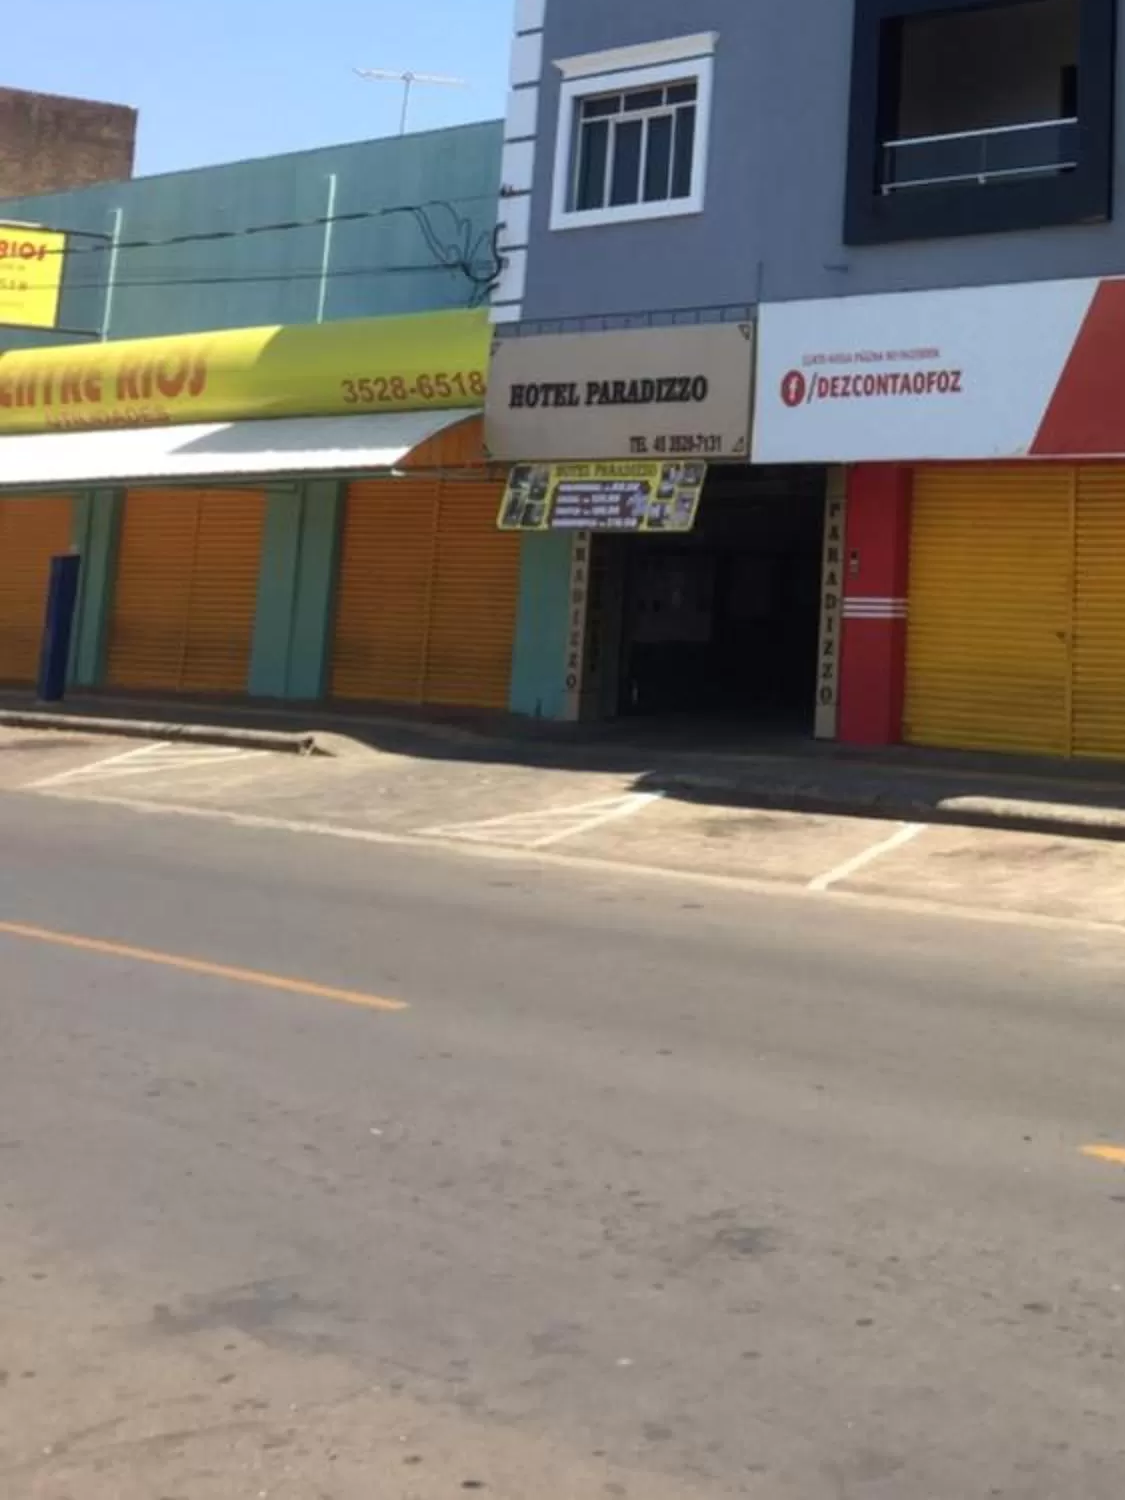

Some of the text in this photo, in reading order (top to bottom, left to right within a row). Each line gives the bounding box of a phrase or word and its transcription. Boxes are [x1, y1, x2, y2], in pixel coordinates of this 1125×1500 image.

[341, 370, 487, 404] 3528-6518
[508, 375, 709, 409] HOTEL PARADIZZO
[819, 502, 841, 706] PARADIZZO
